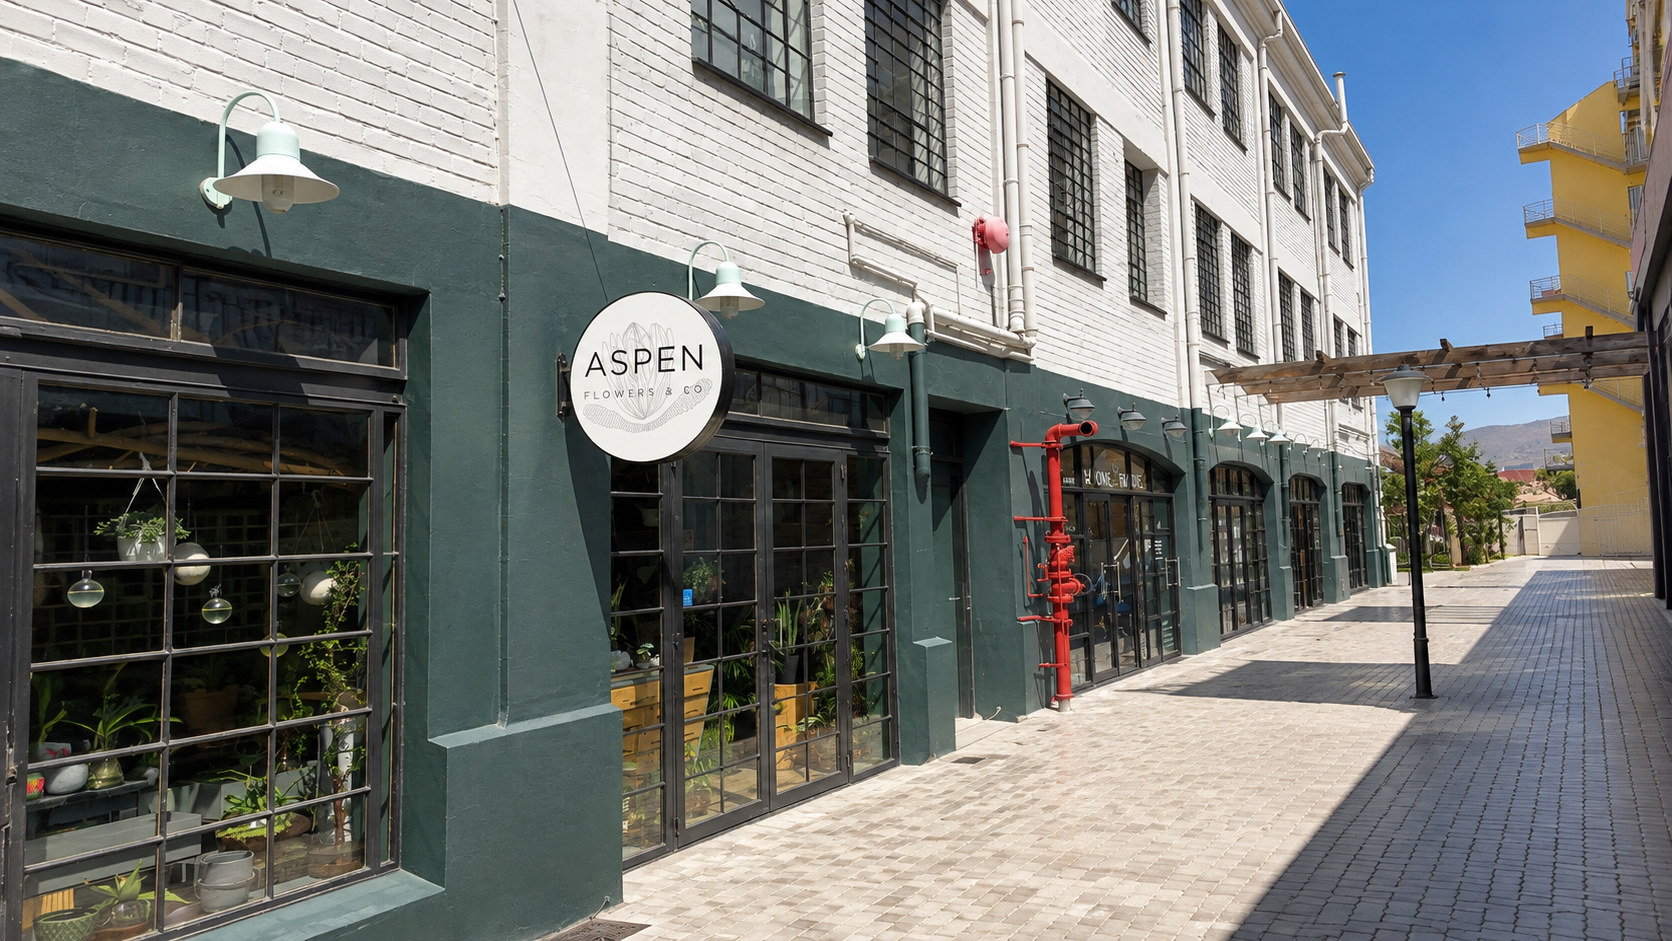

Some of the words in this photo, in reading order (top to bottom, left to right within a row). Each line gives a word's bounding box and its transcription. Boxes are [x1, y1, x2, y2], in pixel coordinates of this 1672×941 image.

[584, 344, 703, 378] ASPEN
[583, 387, 655, 400] FLOWERS
[665, 386, 673, 396] &
[683, 384, 703, 395] CO
